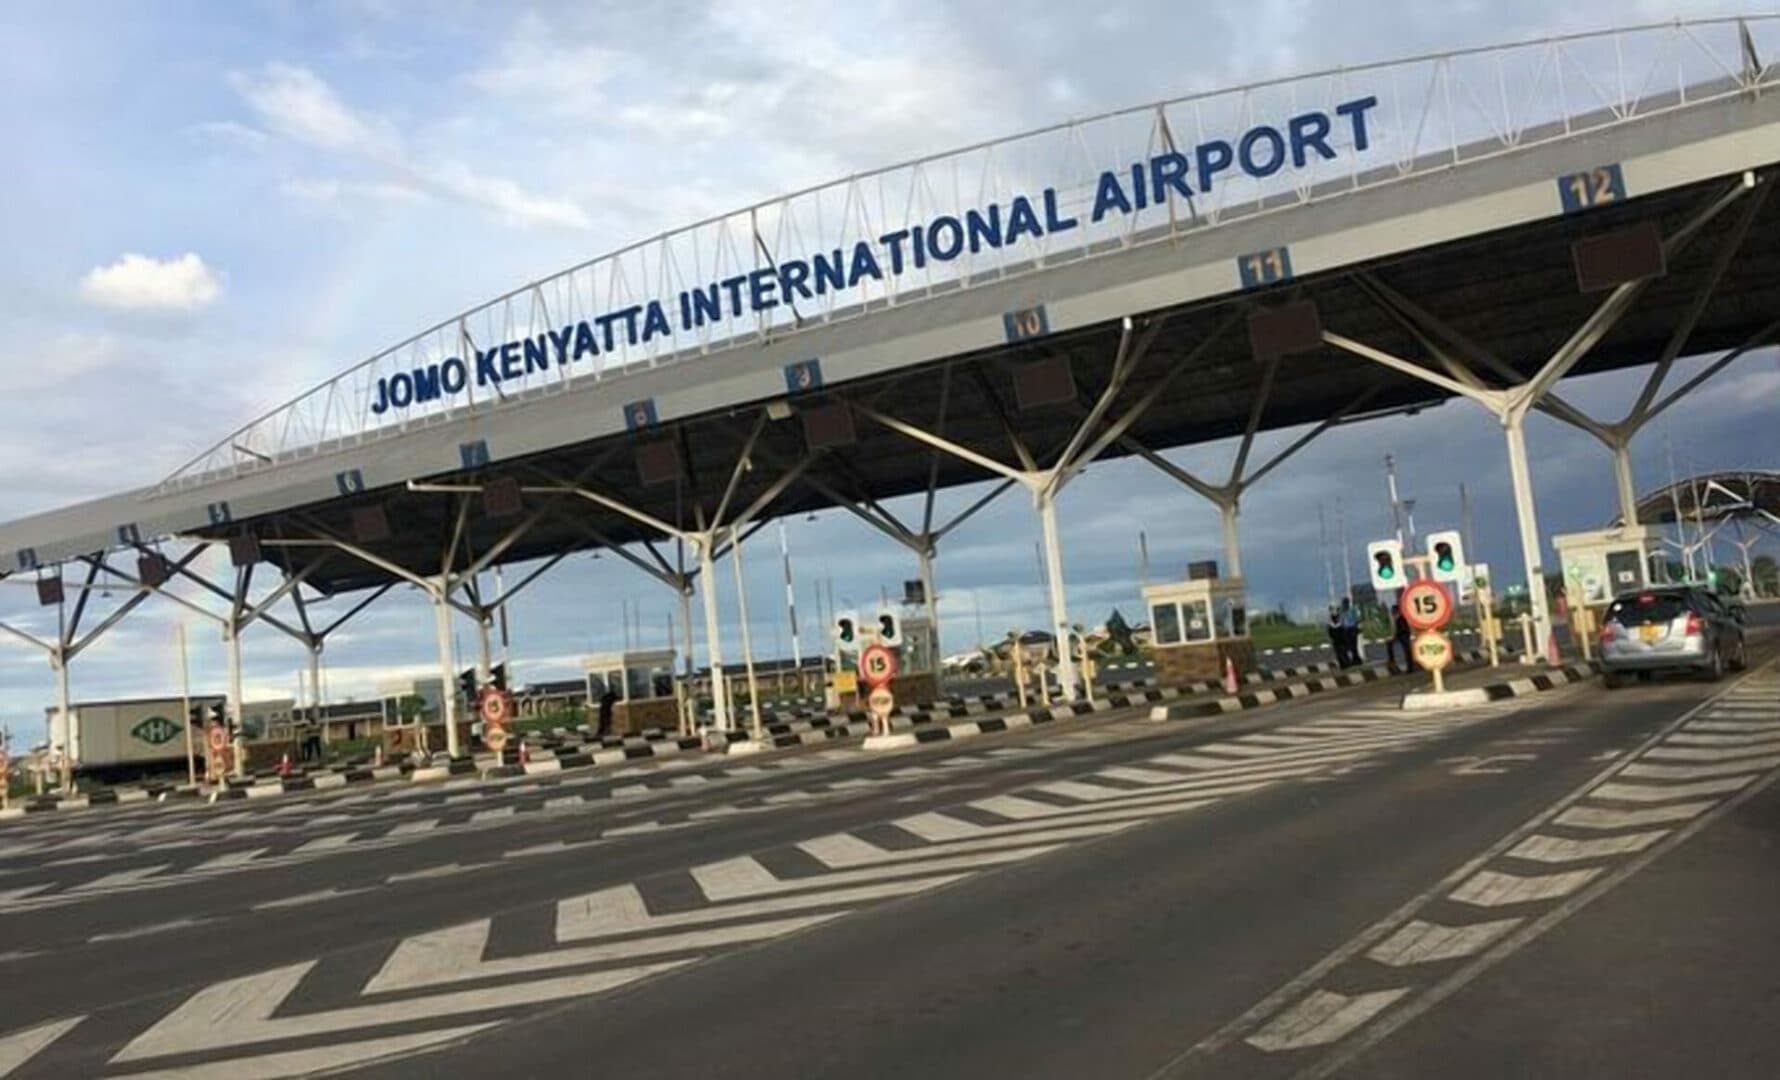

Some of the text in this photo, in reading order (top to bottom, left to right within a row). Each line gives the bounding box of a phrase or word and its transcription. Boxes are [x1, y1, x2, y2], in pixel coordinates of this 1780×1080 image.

[1570, 168, 1616, 208] 12
[372, 96, 1378, 413] JOMO KENYATTA INTERNATIONAL AIRPORT
[1247, 249, 1283, 284] 11
[1014, 309, 1041, 337] 10
[1413, 594, 1438, 615] 15
[869, 656, 886, 673] 15
